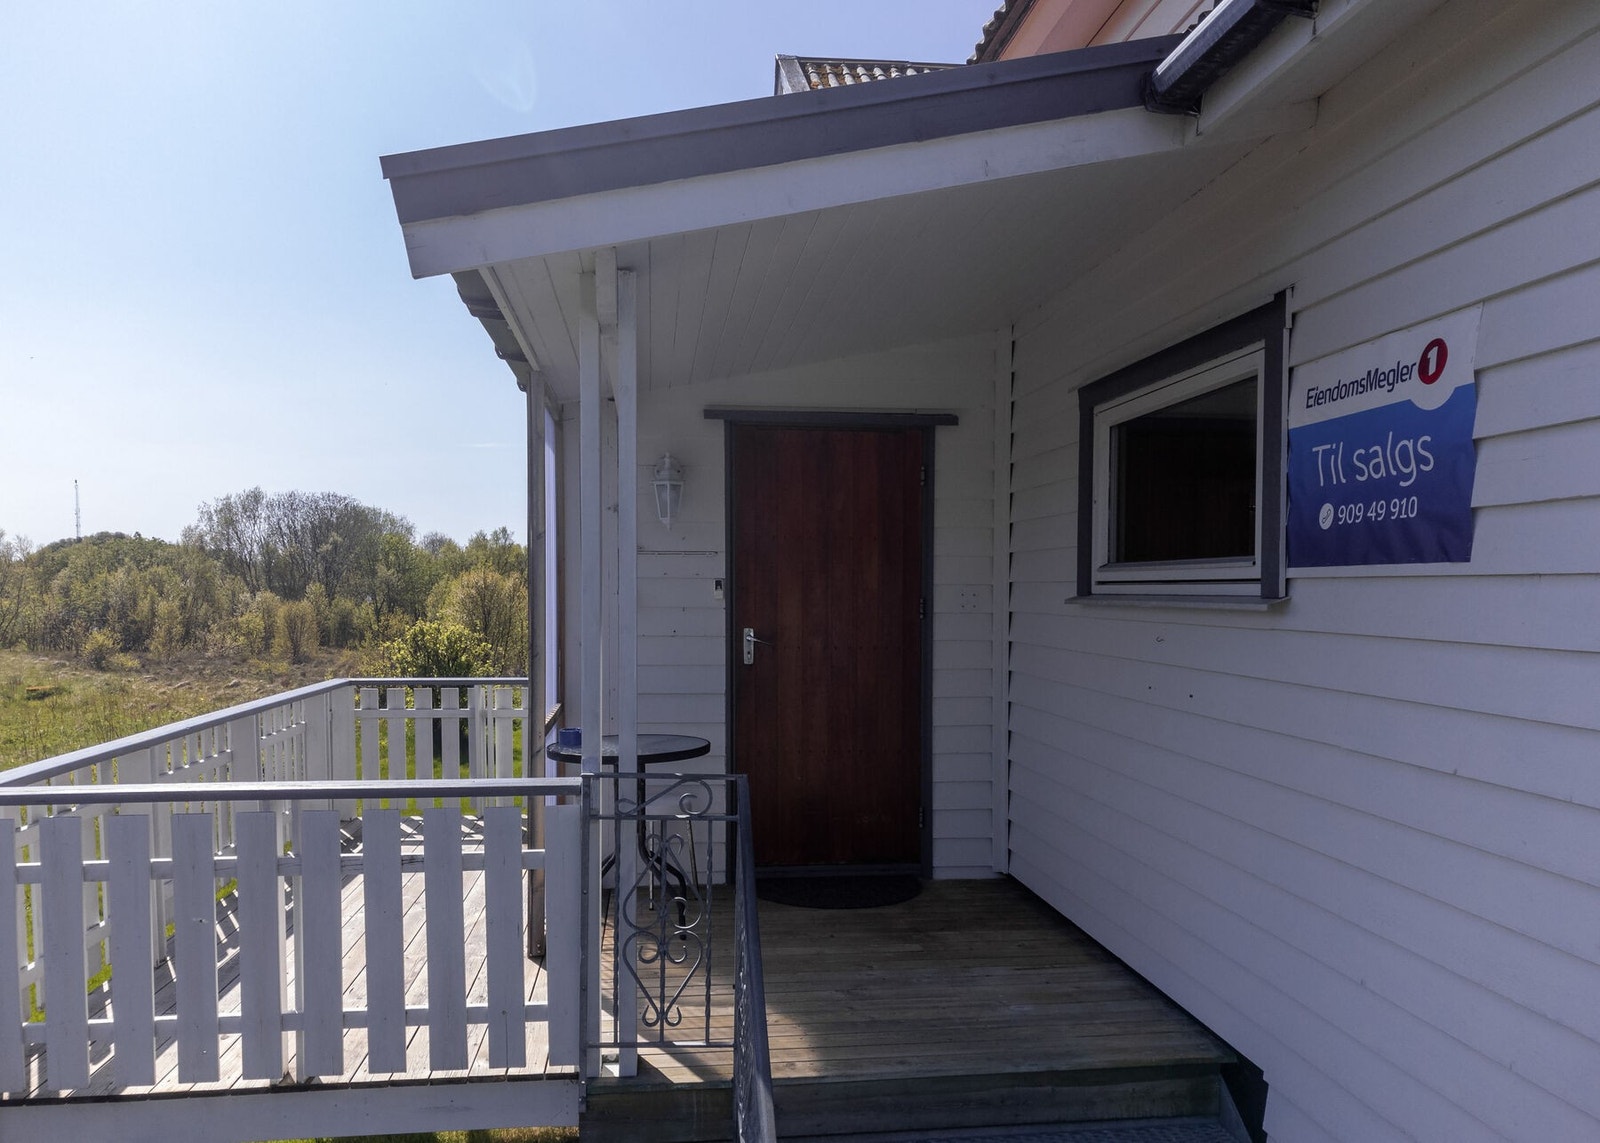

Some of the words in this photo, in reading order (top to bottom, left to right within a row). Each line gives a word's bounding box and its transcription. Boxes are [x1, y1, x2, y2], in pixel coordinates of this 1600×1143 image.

[1305, 360, 1417, 409] EiendomsMegler
[1312, 442, 1347, 487] Til
[1353, 431, 1435, 487] salgs
[1337, 503, 1364, 525] 909
[1367, 500, 1386, 522] 49
[1390, 496, 1418, 520] 910
